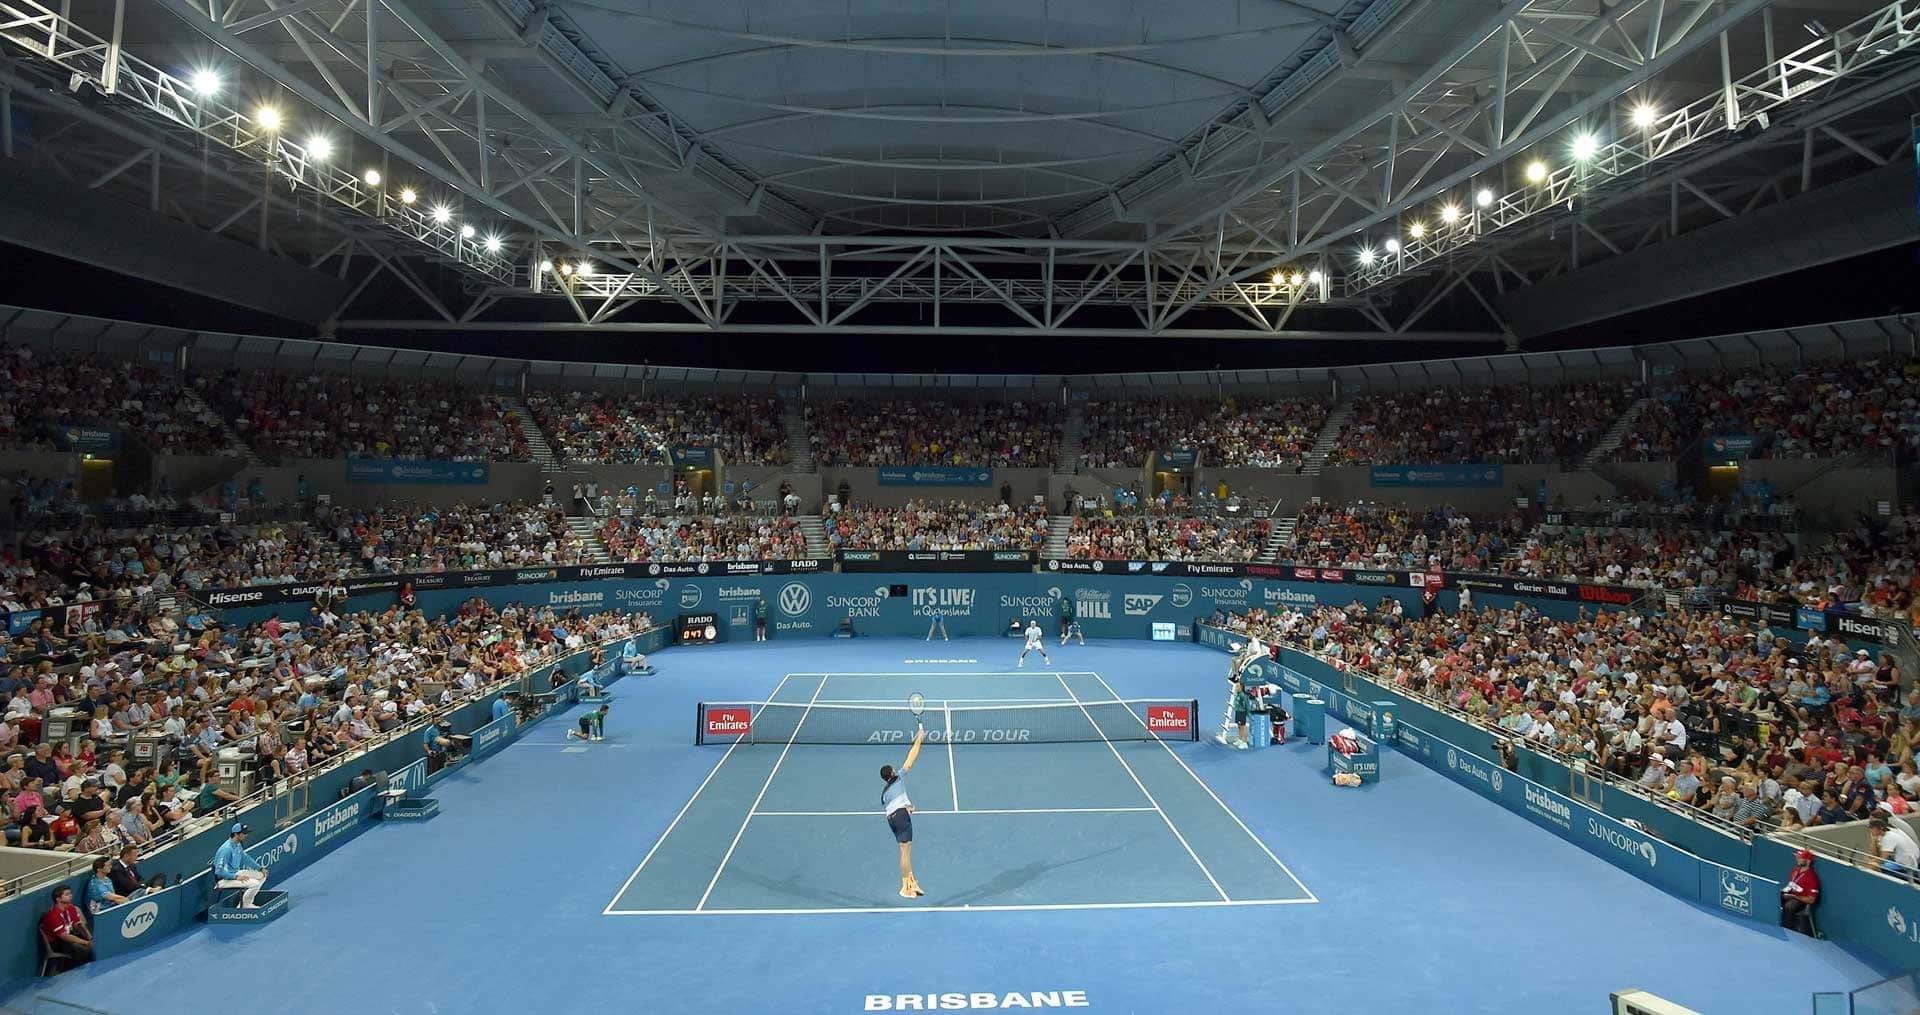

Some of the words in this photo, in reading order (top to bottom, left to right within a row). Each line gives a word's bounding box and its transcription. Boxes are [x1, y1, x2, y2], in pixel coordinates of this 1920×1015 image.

[580, 568, 593, 577] Fly
[593, 566, 625, 576] Emirates
[677, 565, 695, 573] Auto.
[727, 562, 758, 570] brisbane
[1187, 564, 1201, 573] Fly
[1201, 565, 1234, 573] Emirates
[415, 577, 444, 585] TREASURY
[517, 572, 548, 580] SUNCORP
[1355, 573, 1386, 582] SUNCORP
[292, 586, 322, 595] DIADO
[719, 587, 761, 597] brisbane
[1201, 587, 1247, 598] SUNCORP
[1513, 582, 1543, 593] Courier
[1548, 585, 1567, 595] Mail
[1579, 584, 1632, 603] Wilson
[209, 591, 263, 604] Hisense
[550, 589, 604, 604] brisbane
[616, 589, 663, 600] SUNCORP
[912, 587, 937, 606] IT'S
[940, 588, 976, 607] LIVE!
[1264, 587, 1316, 603] brisbane
[628, 599, 662, 607] Insurance
[827, 595, 881, 607] SUNCORP
[1001, 595, 1053, 607] SUNCORP
[1126, 598, 1153, 611] SAP
[1215, 598, 1247, 606] Insurance
[848, 607, 880, 617] BANK
[913, 606, 921, 616] in
[1022, 607, 1053, 617] BANK
[1076, 601, 1111, 618] HILL
[687, 616, 712, 624] RADO
[776, 622, 791, 630] Das
[792, 621, 812, 630] Auto.
[1839, 618, 1888, 638] Hisen
[709, 720, 748, 730] Emirates
[1150, 716, 1187, 728] Emirates
[867, 730, 903, 742] ATP
[910, 729, 976, 742] WORLD
[983, 729, 1030, 741] TOUR
[1459, 758, 1471, 773] Das
[1472, 765, 1489, 782] Auto.
[1525, 784, 1570, 820] brisbane
[314, 802, 359, 836] brisbane
[1588, 817, 1639, 856] SUNCORP
[1734, 873, 1749, 883] 250
[1722, 895, 1749, 908] ATP
[125, 909, 157, 930] WTA
[864, 990, 1090, 1011] BRISBANE
